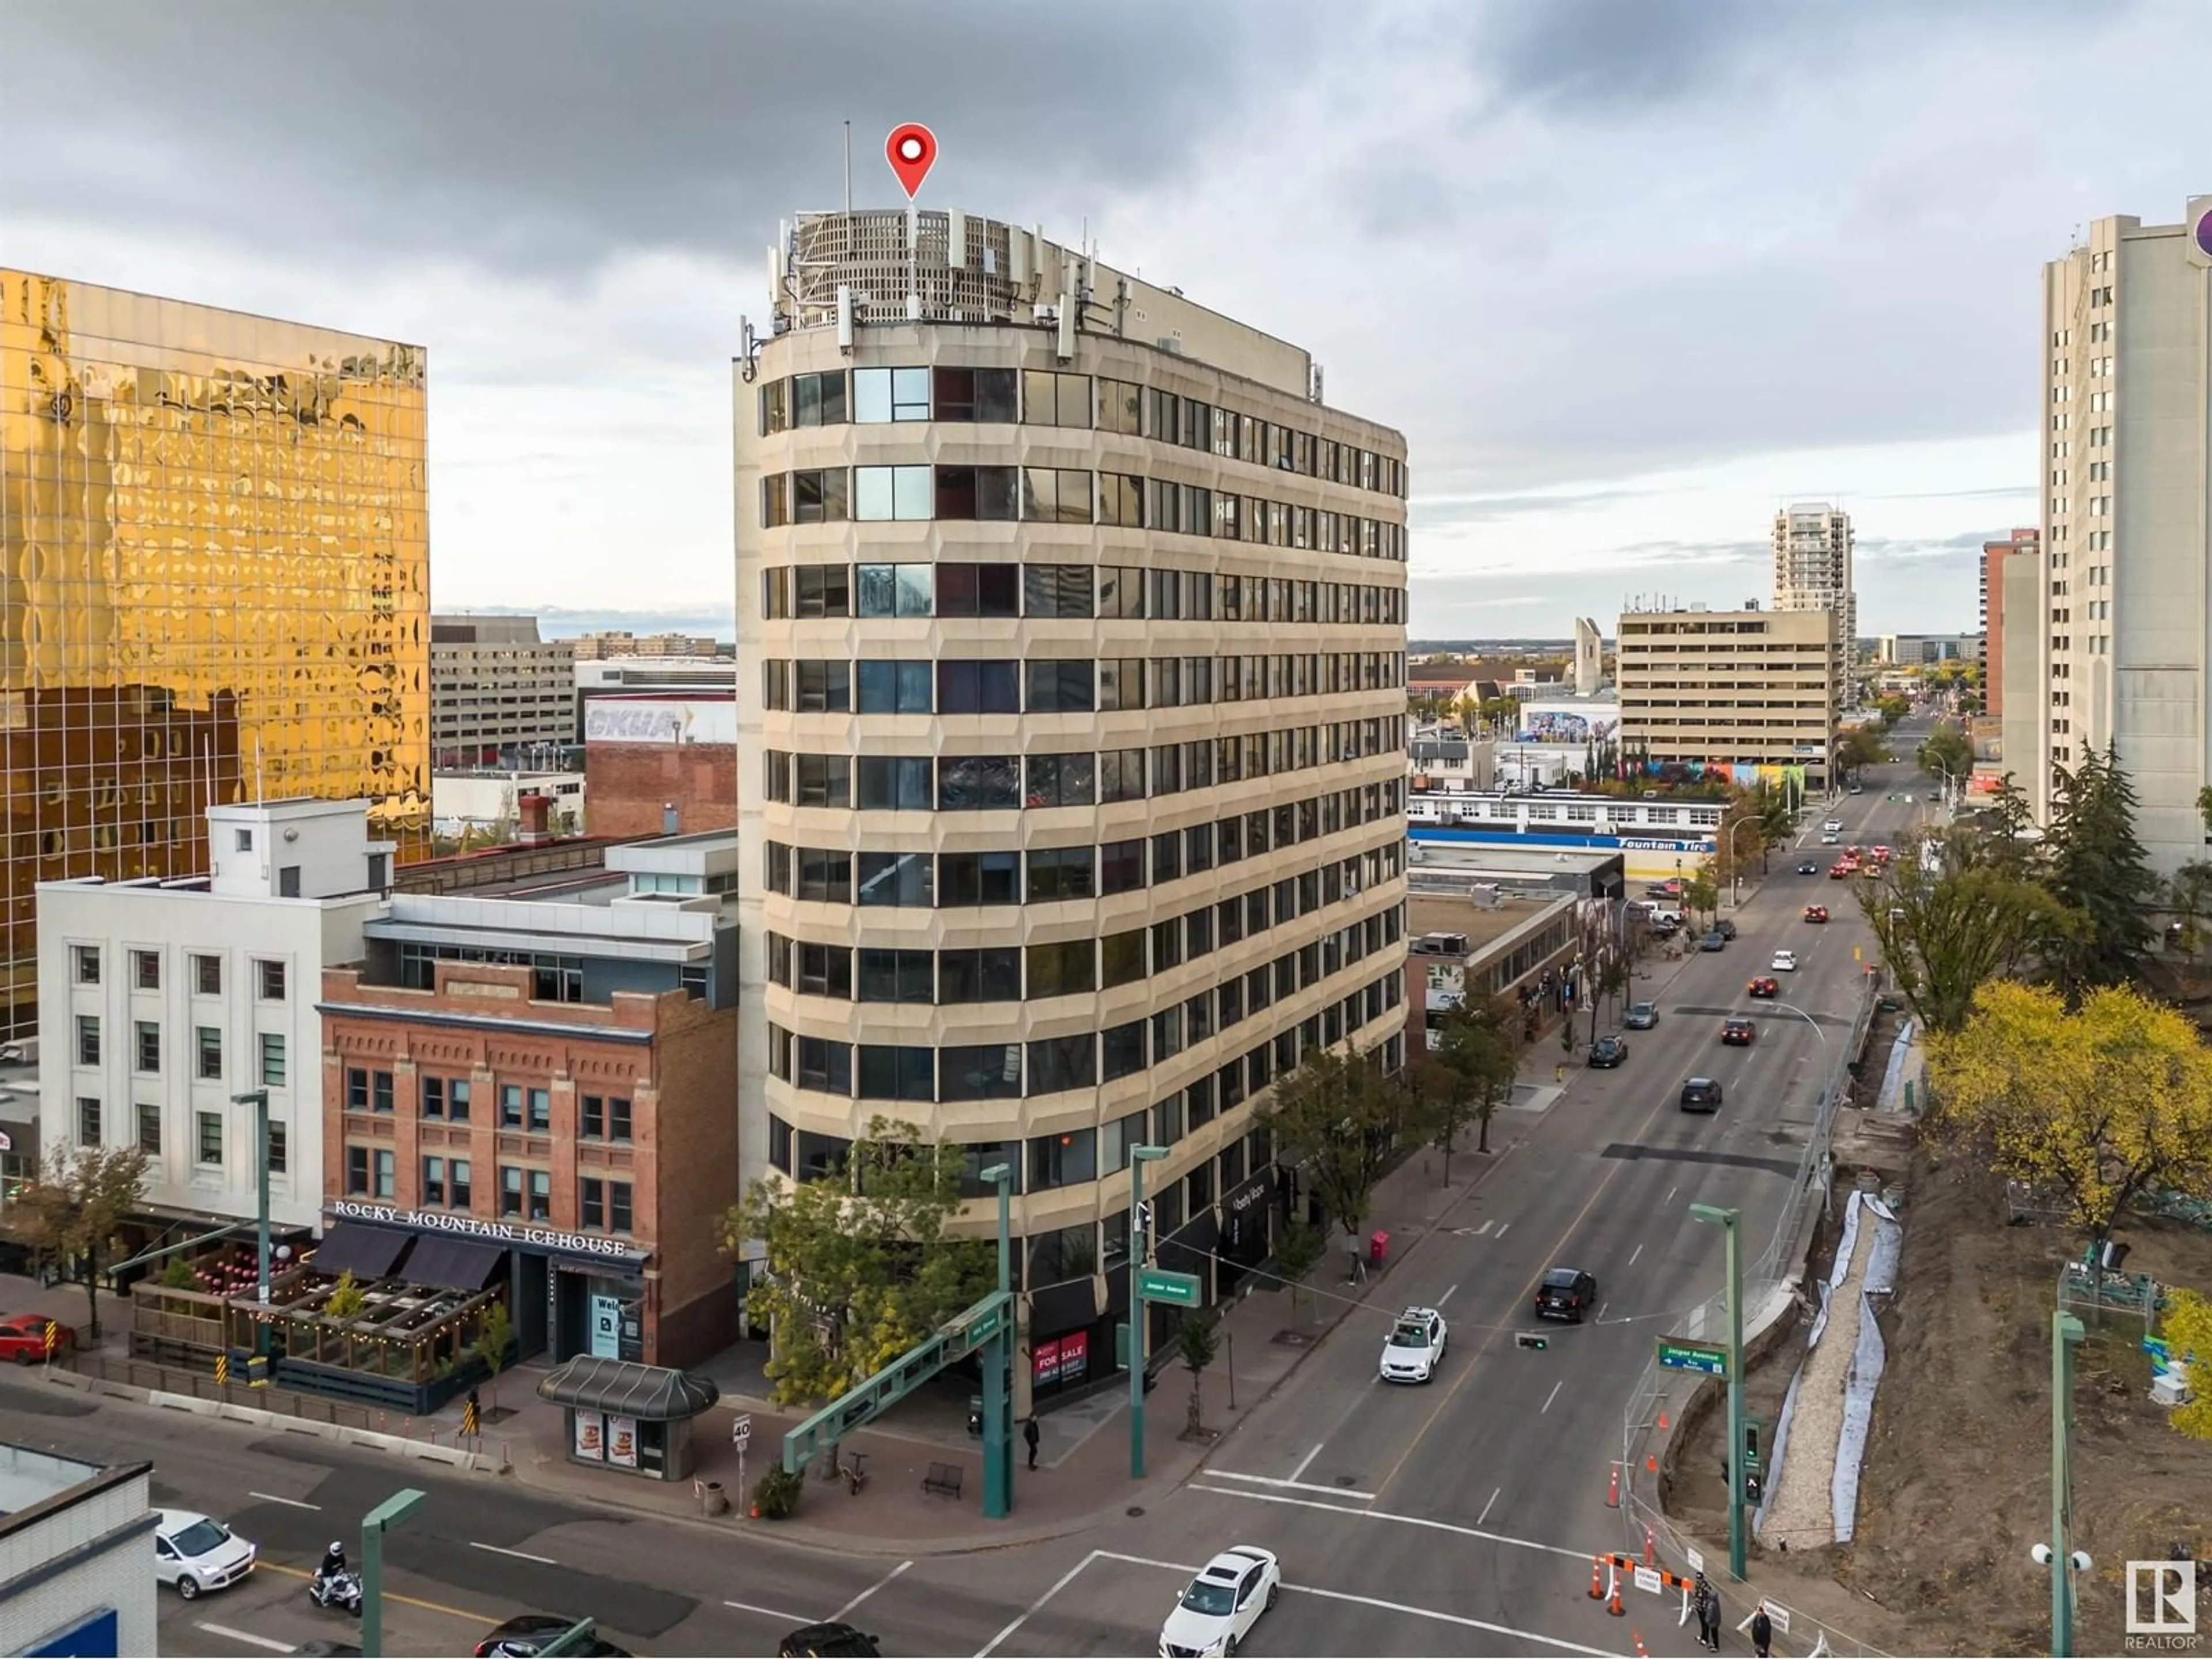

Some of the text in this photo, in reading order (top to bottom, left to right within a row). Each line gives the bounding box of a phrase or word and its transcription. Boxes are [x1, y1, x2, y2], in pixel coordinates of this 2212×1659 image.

[1618, 839, 1707, 852] Fountain Tire
[335, 1201, 626, 1256] ROCKY MOUNTAIN ICEHOUSE
[1039, 1355, 1058, 1369] FOR
[1062, 1345, 1083, 1361] SALE
[734, 1423, 749, 1436] 40
